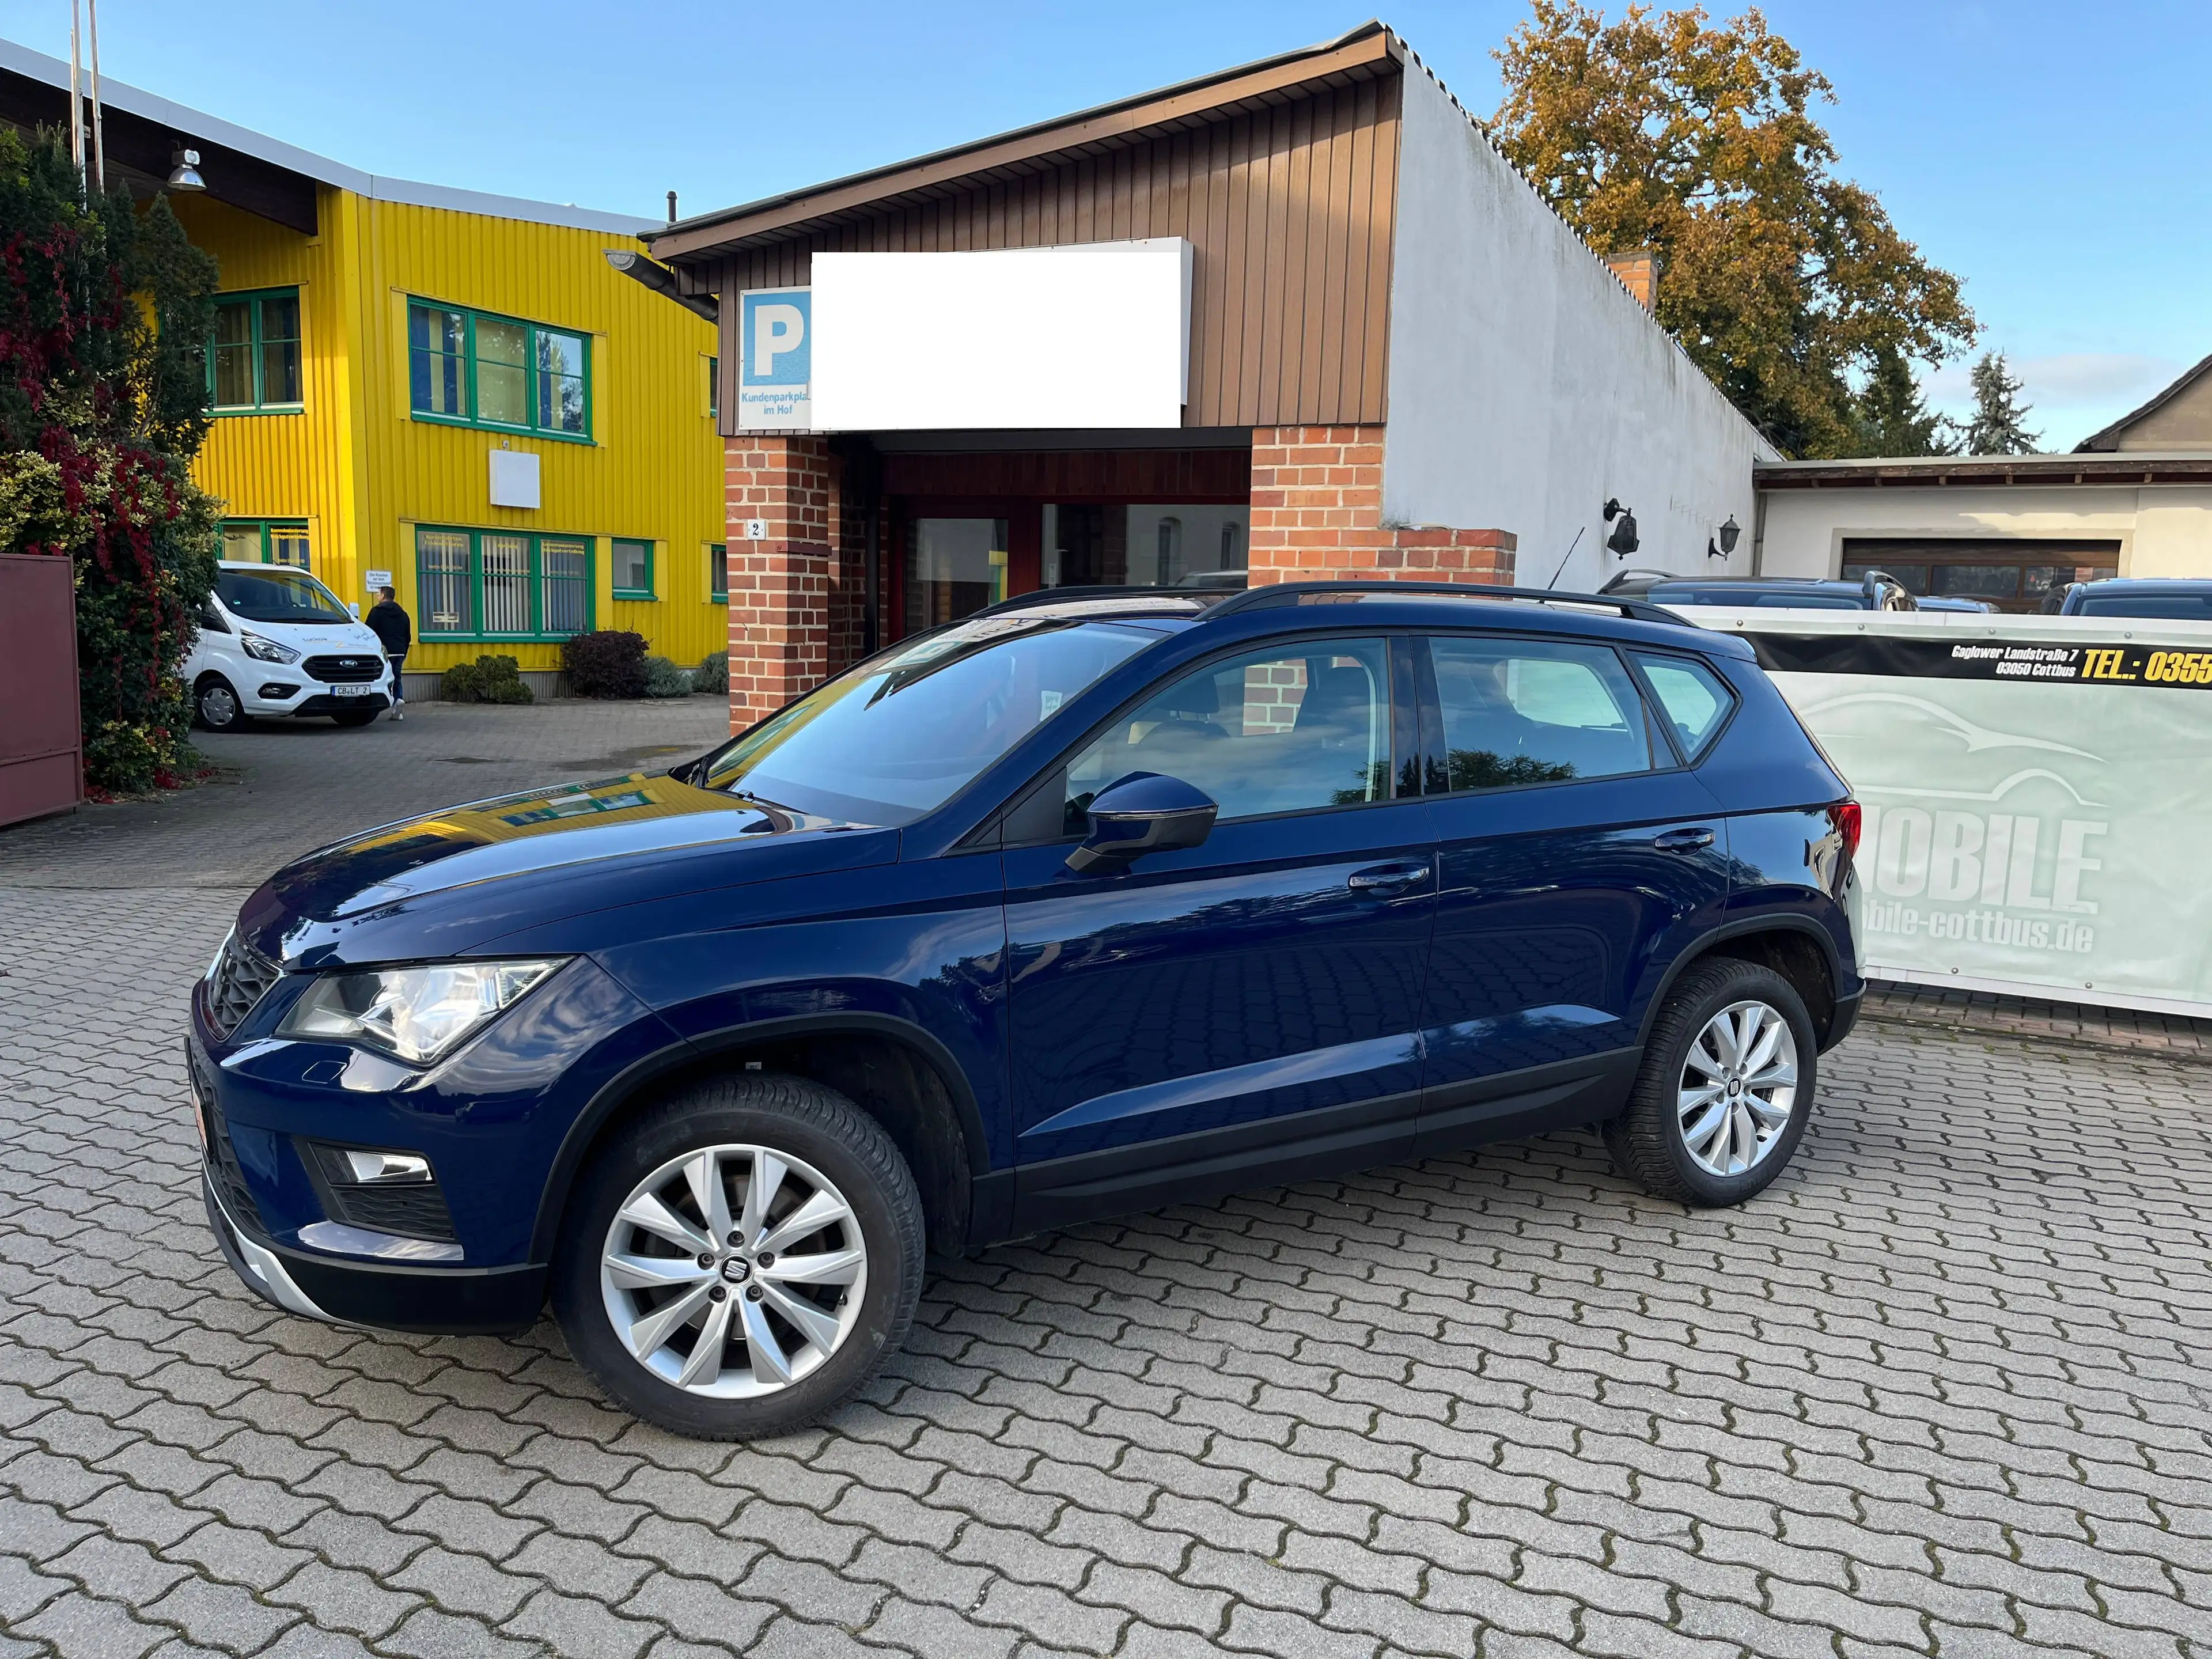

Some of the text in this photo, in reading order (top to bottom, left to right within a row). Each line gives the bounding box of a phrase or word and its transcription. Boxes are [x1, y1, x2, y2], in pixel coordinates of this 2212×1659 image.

[754, 304, 804, 376] P
[764, 404, 793, 415] im Hof
[752, 523, 759, 536] 2
[1951, 645, 2080, 662] Gaglower Landstraße 7
[2032, 662, 2077, 677] Cottbus
[2144, 652, 2212, 684] 0355
[1863, 899, 2094, 953] bile-cottbus.de
